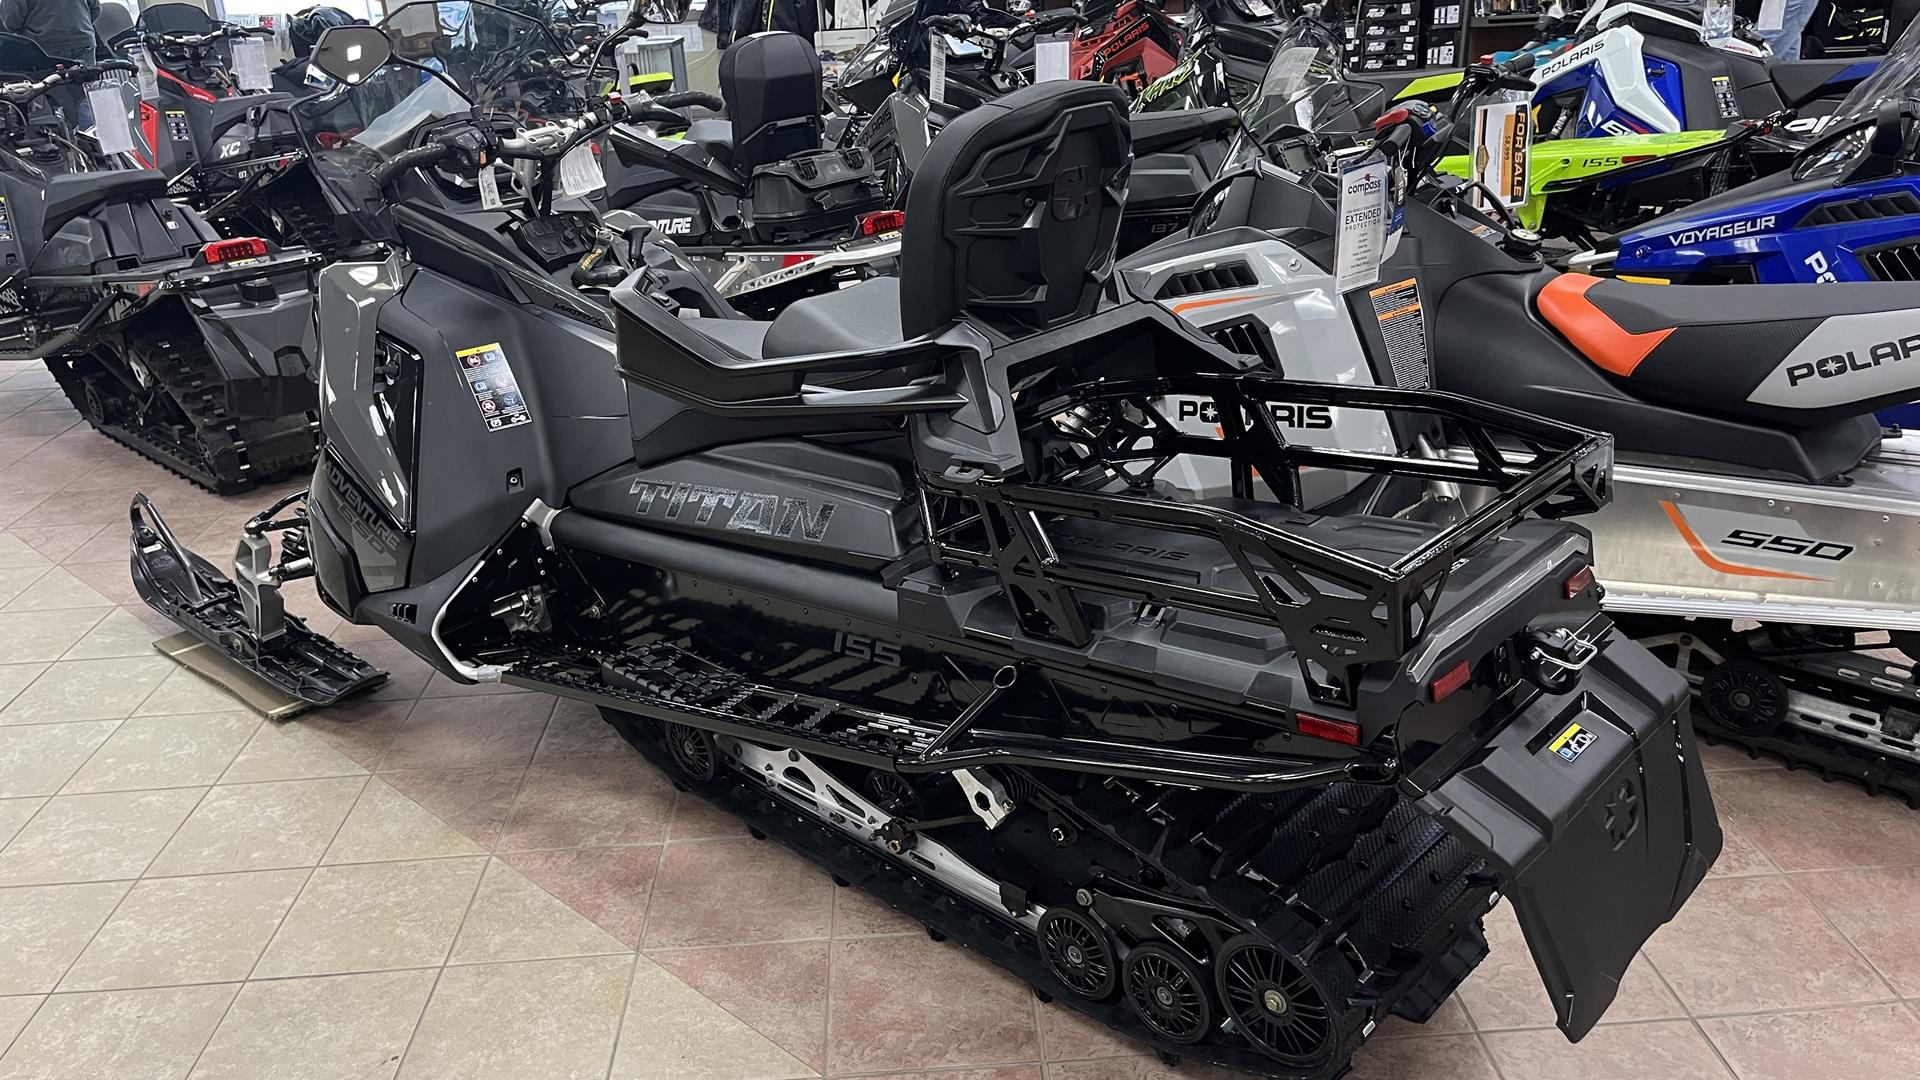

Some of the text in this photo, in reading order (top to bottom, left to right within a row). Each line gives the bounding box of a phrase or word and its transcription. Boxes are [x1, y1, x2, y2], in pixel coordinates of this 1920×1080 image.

[1103, 21, 1150, 58] POLARIS
[1541, 39, 1605, 78] POLARIS
[219, 141, 241, 158] XC
[1513, 112, 1526, 197] FOR SALE
[1582, 156, 1620, 168] 155
[1347, 179, 1381, 196] compass
[1344, 219, 1381, 232] PROTECTION
[1345, 207, 1382, 225] EXTENDED
[1668, 215, 1776, 247] VOYAGEUR
[553, 302, 603, 326] MATRYX
[1178, 400, 1333, 429] PORIS
[324, 460, 401, 551] ADVENTURE
[628, 479, 838, 543] TITAN
[1720, 529, 1854, 561] 550
[833, 631, 903, 668] 155
